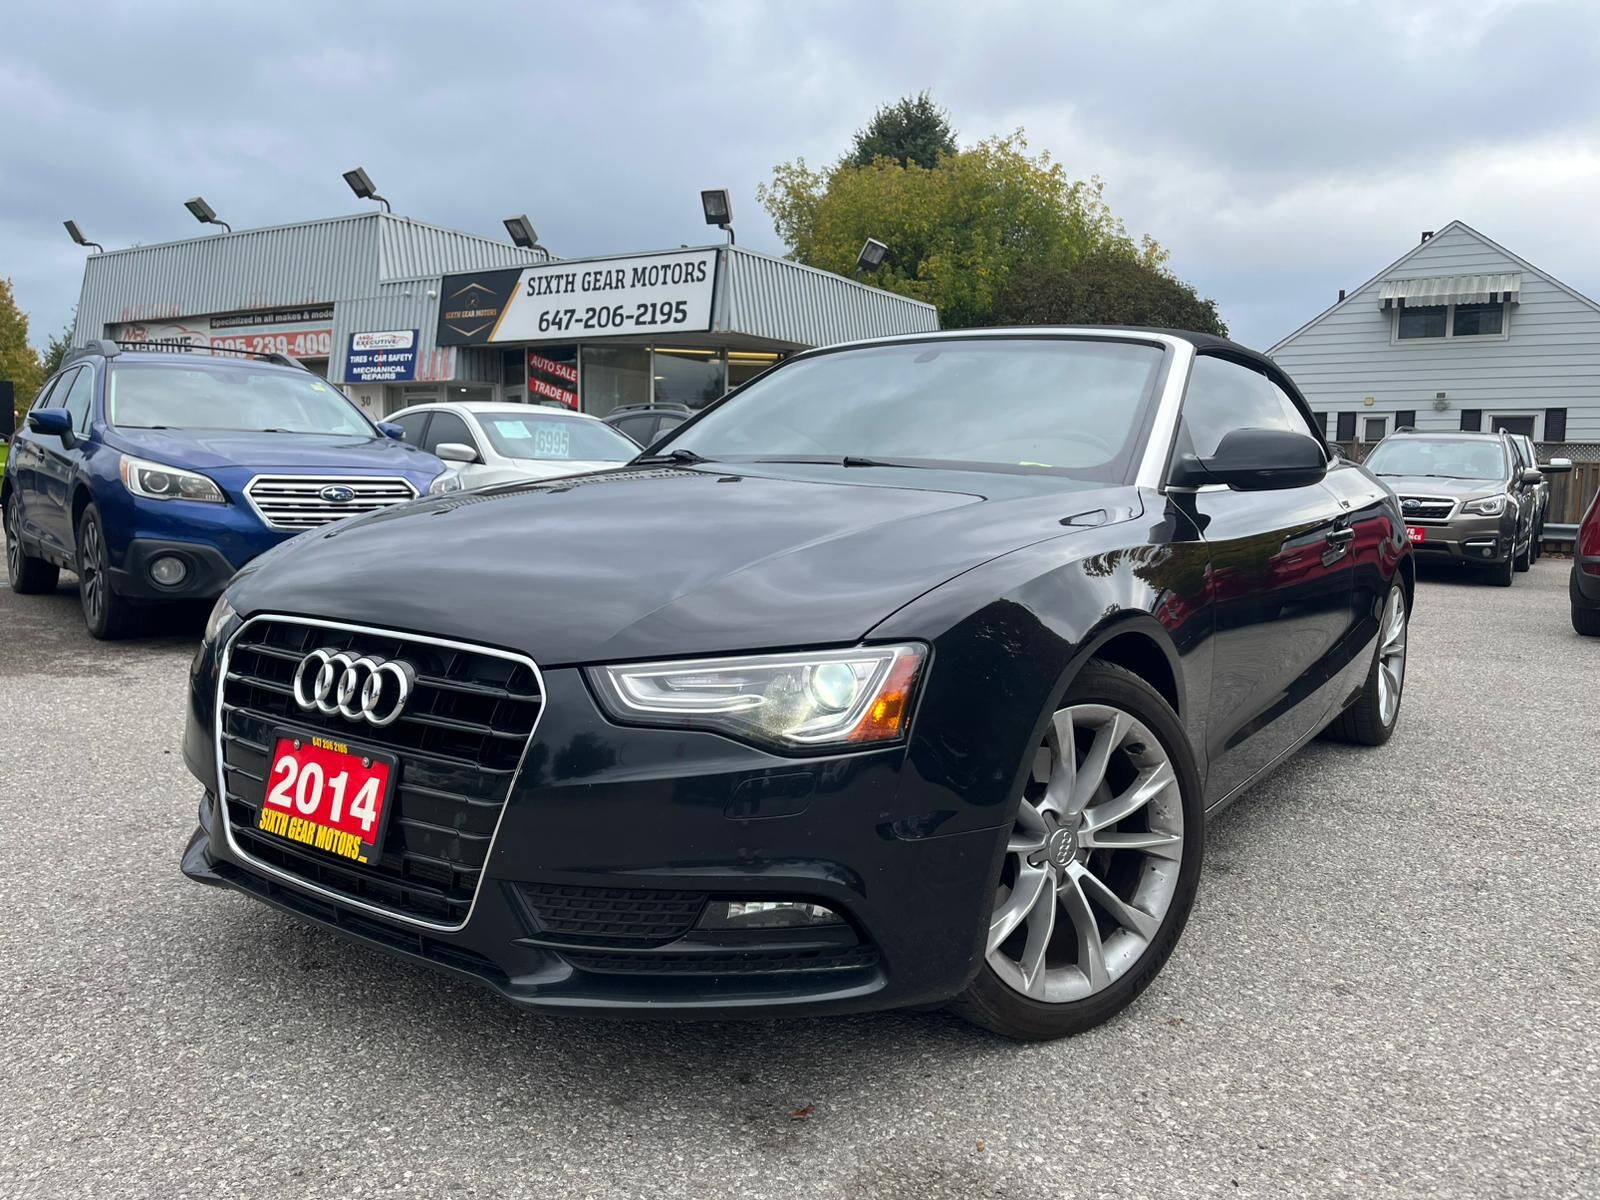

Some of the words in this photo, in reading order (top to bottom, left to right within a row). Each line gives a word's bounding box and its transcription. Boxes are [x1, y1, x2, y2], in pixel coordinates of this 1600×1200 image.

[527, 273, 576, 297] SIXTH
[581, 268, 626, 292] GEAR
[630, 260, 708, 289] MOTORS
[211, 316, 254, 328] Specialized
[254, 315, 263, 324] in
[263, 314, 274, 323] all
[275, 312, 301, 322] makes
[303, 311, 310, 319] &
[538, 300, 688, 332] 647-206-2195
[350, 354, 368, 363] TIRES
[373, 354, 387, 363] CAR
[388, 353, 413, 362] SAFETY
[530, 354, 554, 374] AUTO
[555, 363, 577, 382] SALE
[352, 366, 406, 375] MECHANICAL
[361, 373, 396, 381] REPAIRS
[360, 396, 372, 407] 30
[535, 380, 561, 400] TRADE
[561, 391, 572, 404] IN
[267, 754, 381, 832] 2014
[259, 807, 287, 836] SIXTH
[288, 815, 317, 846] GEAR
[316, 825, 362, 860] MOTORS
